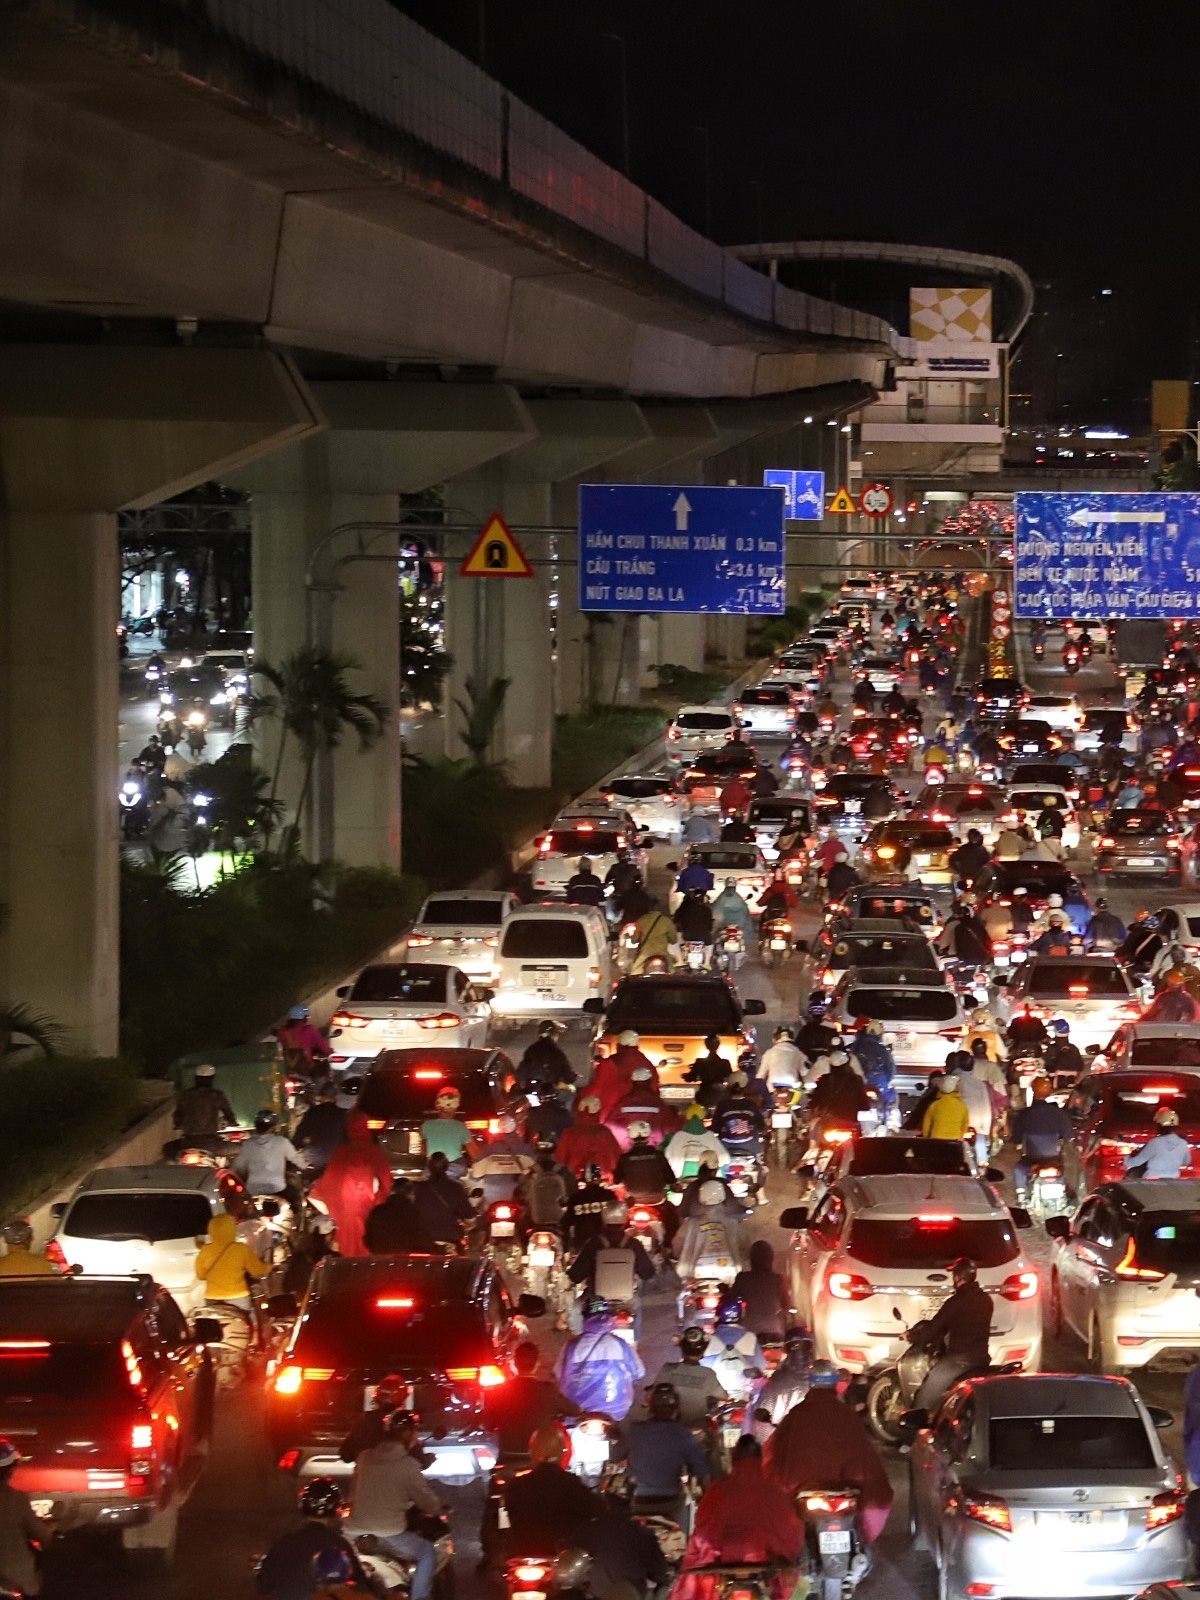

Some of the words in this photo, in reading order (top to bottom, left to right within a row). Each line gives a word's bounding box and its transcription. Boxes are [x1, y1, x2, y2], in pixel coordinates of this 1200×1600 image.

[617, 535, 645, 549] CHUI
[651, 535, 690, 550] THANH
[693, 533, 727, 550] XUÂN
[758, 537, 778, 552] km
[586, 554, 610, 575] CẦU
[615, 554, 656, 575] TRẮNG
[757, 563, 778, 578] km
[1185, 568, 1195, 583] 5
[586, 581, 611, 600] NÚT
[615, 586, 644, 601] GIAO
[647, 586, 664, 601] BA
[668, 587, 685, 602] LA
